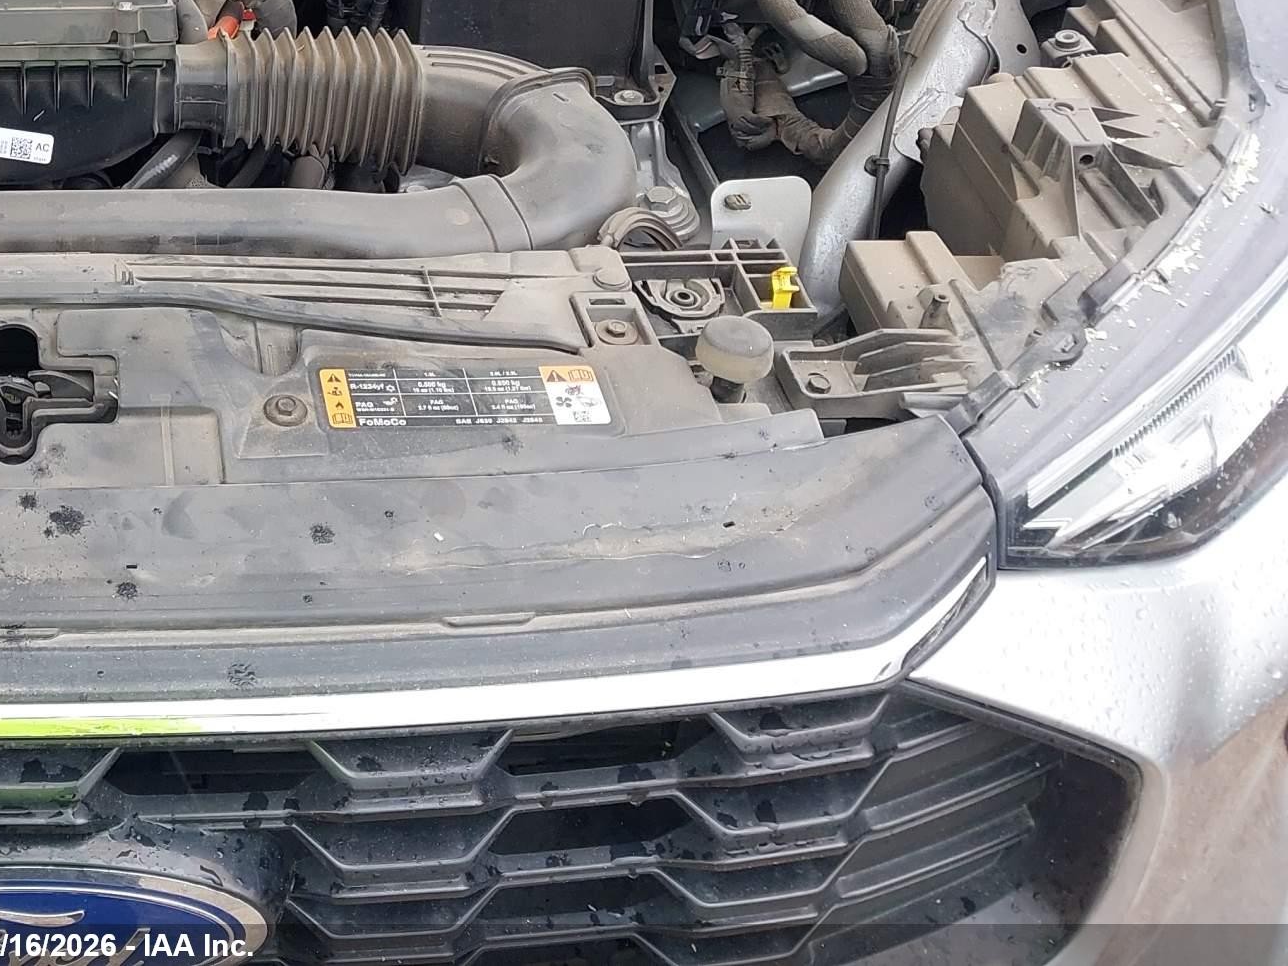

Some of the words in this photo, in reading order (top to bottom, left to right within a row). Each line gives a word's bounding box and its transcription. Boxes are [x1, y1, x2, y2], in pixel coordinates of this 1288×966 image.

[35, 142, 50, 152] AC
[349, 383, 385, 391] R-1234yf
[358, 418, 408, 426] FoMoCo
